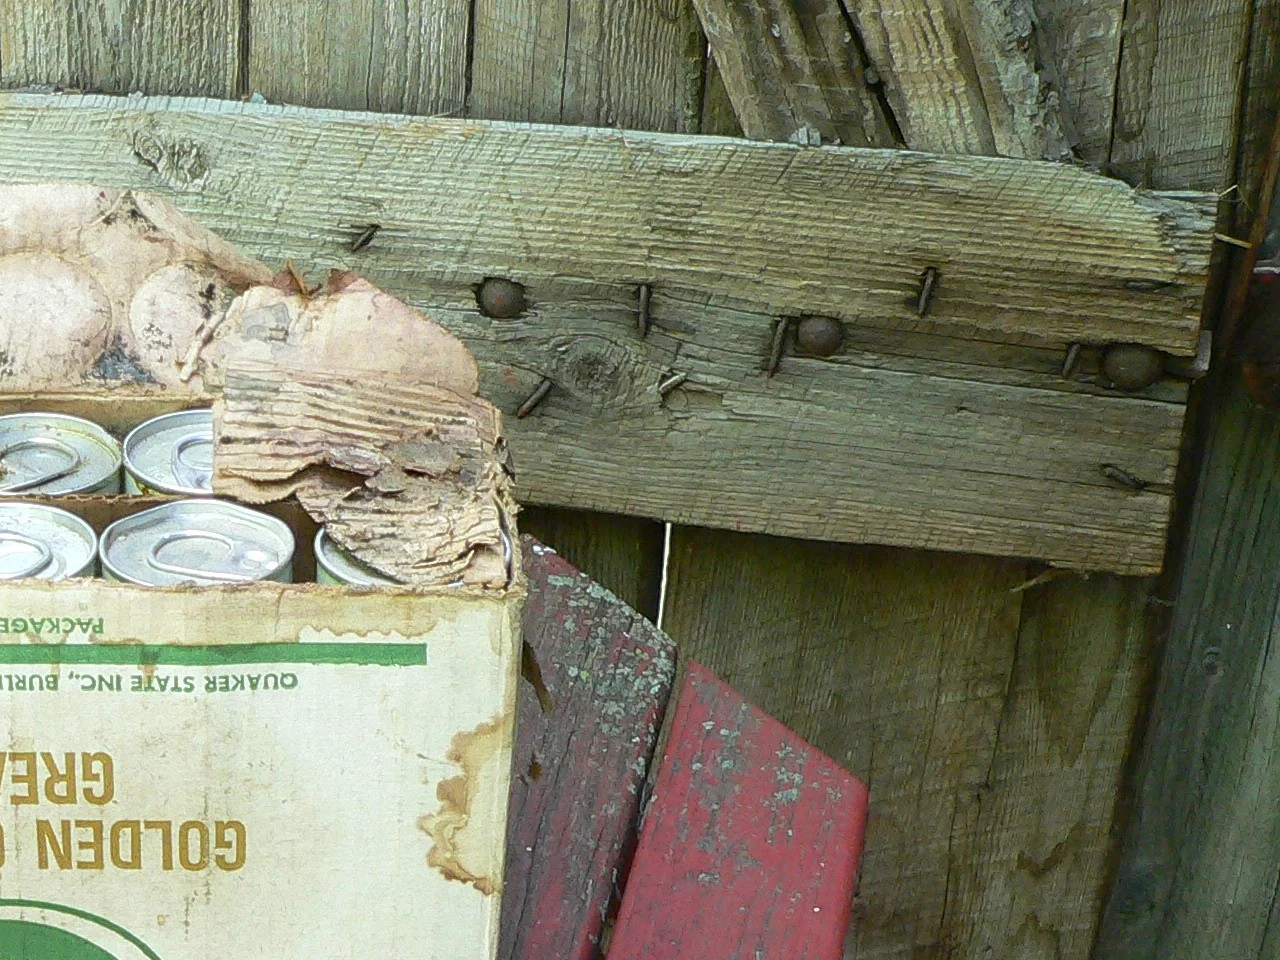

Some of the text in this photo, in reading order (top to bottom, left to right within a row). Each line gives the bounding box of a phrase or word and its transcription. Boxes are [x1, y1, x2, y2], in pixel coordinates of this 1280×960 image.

[67, 671, 121, 691] INC.,
[131, 674, 195, 691] STATE
[204, 672, 299, 692] QUAKER
[36, 820, 247, 872] GOLDEN
